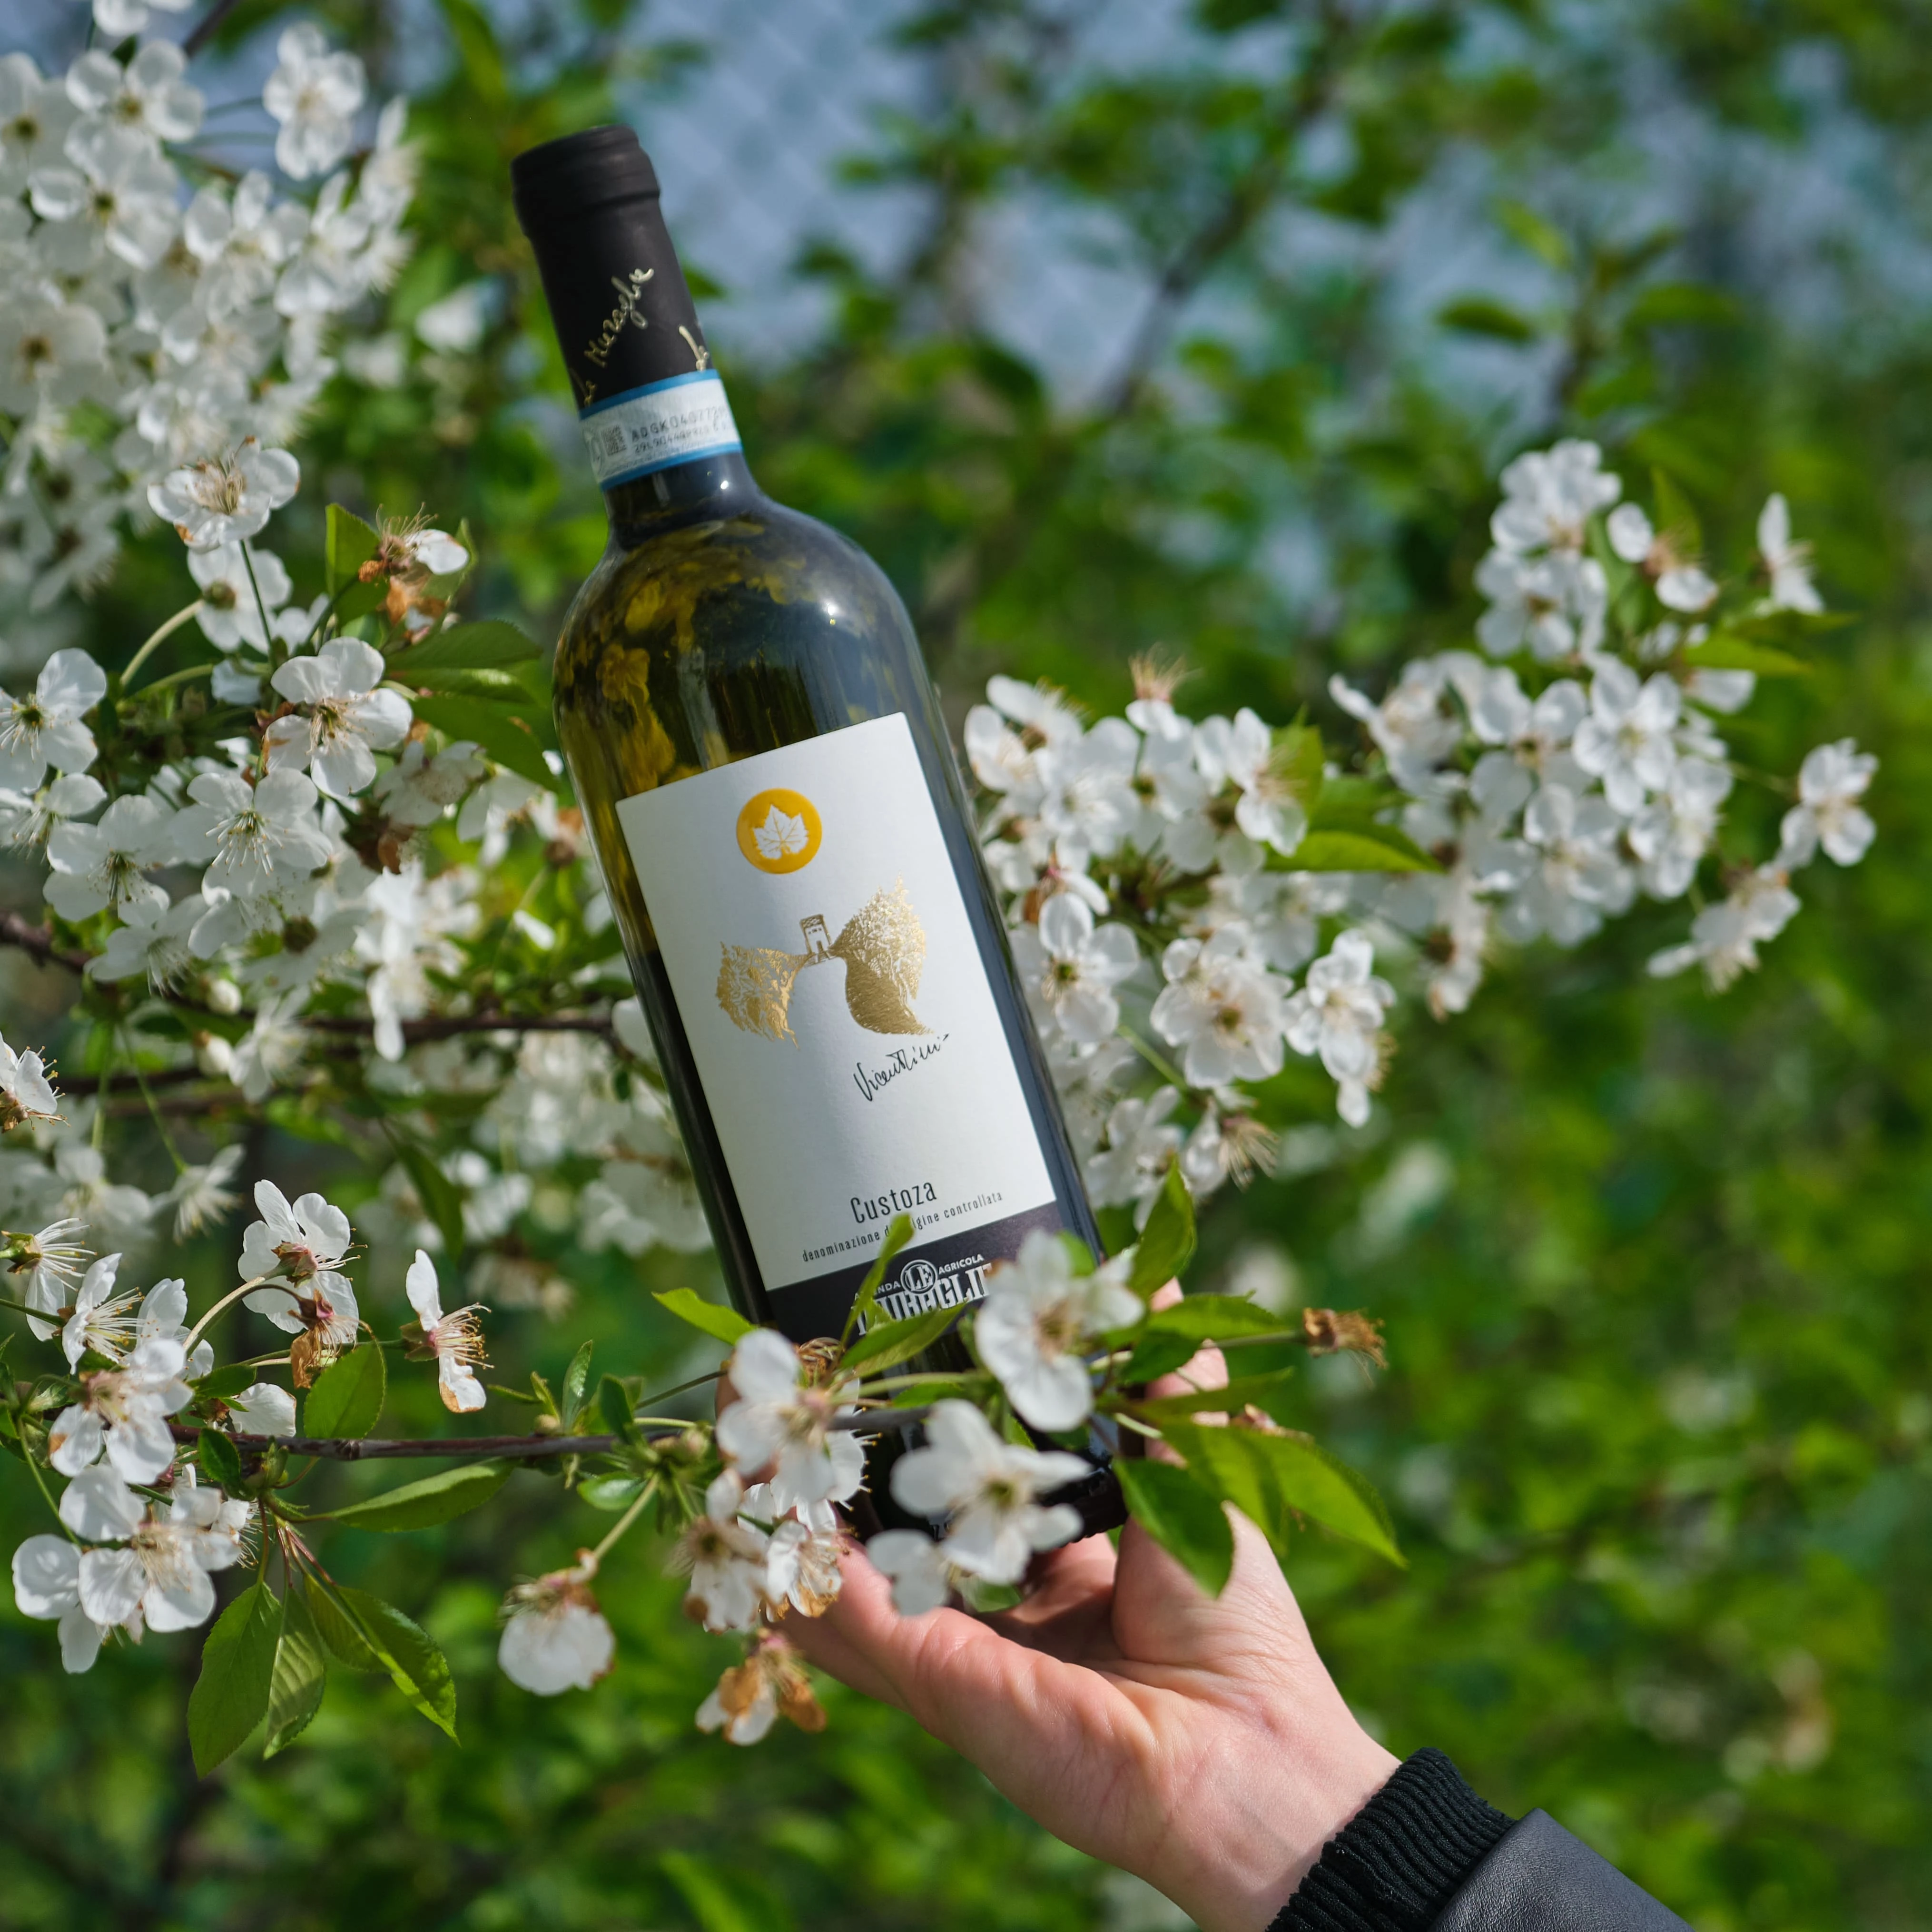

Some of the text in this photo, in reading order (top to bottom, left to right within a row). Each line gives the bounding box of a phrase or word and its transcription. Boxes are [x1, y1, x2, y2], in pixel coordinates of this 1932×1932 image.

[802, 1231, 880, 1262] denominazione
[909, 1211, 940, 1232] igine
[943, 1191, 1003, 1219] controllata
[850, 1182, 937, 1224] Custoza
[854, 1280, 901, 1301] ANDA
[938, 1253, 985, 1275] AGRICOLA
